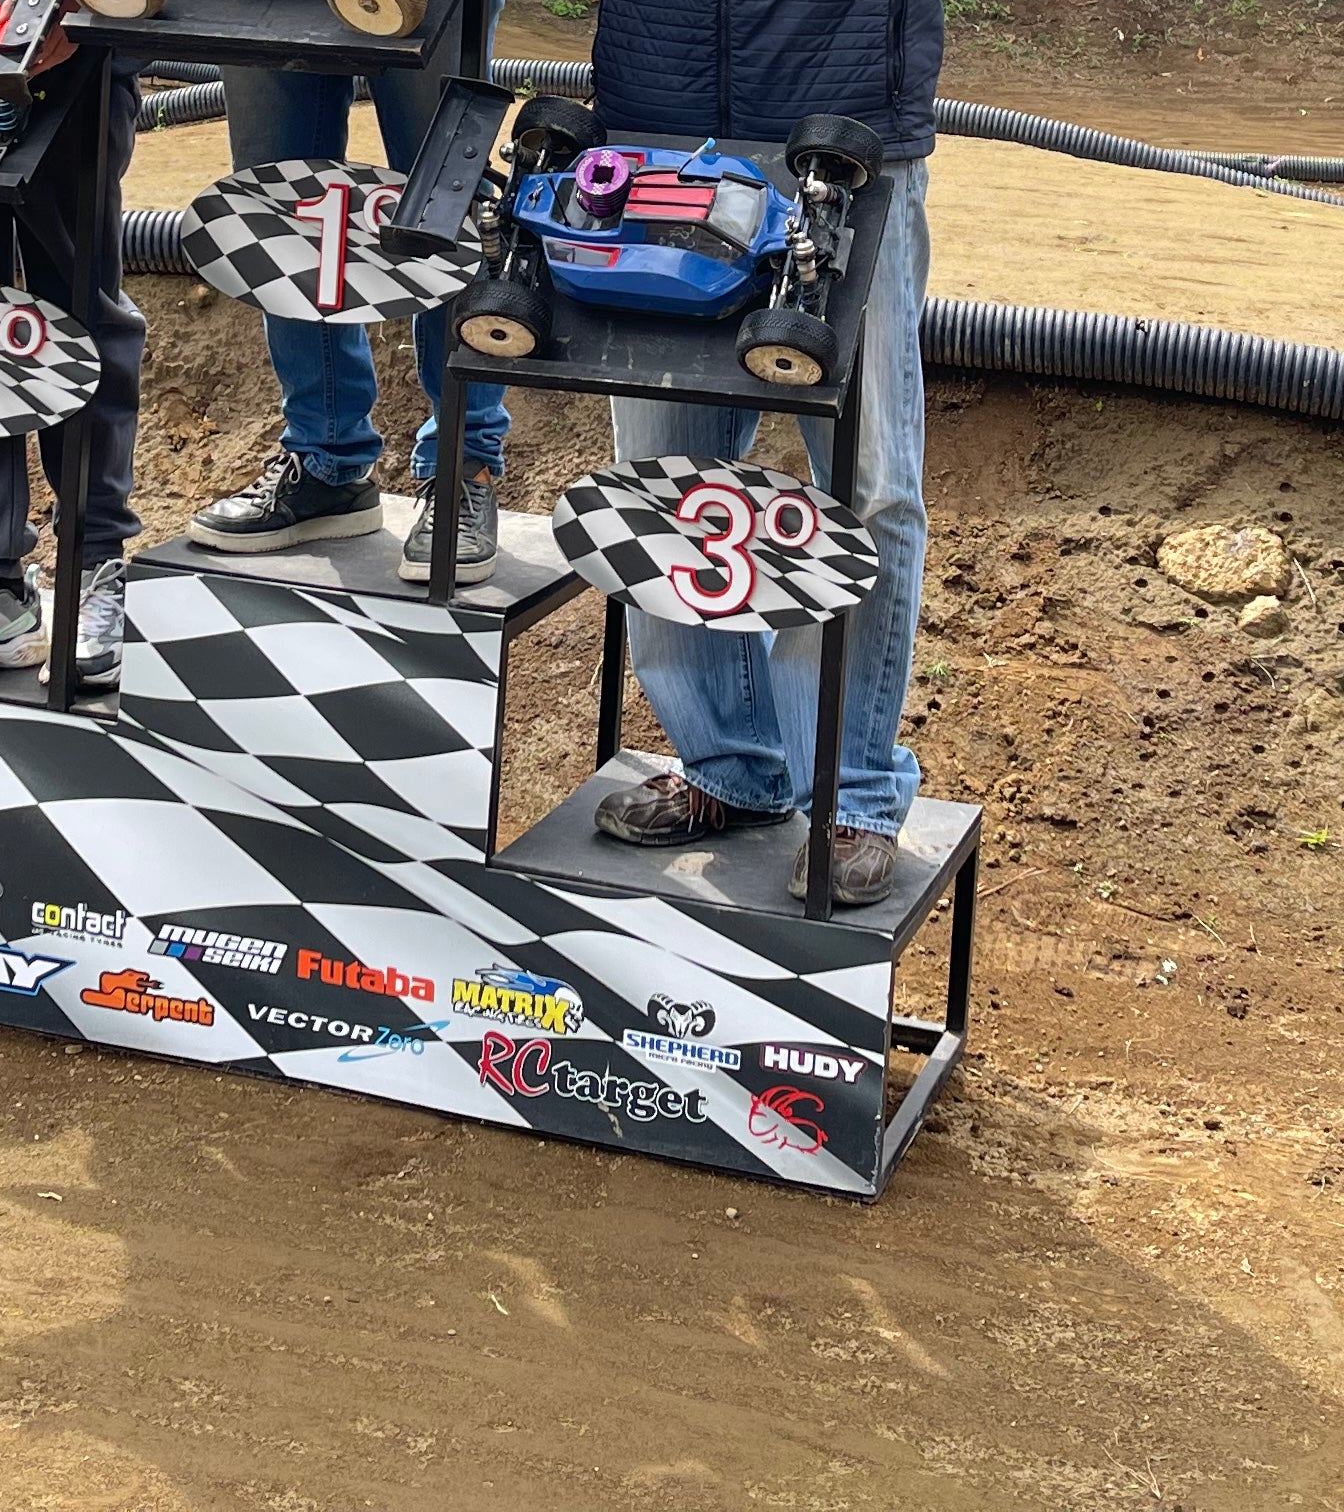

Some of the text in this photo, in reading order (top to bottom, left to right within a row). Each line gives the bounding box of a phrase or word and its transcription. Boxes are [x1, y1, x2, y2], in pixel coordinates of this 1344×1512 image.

[31, 901, 127, 939] contact
[297, 948, 436, 1003] Futaba
[452, 979, 570, 1035] MATRIX
[625, 1033, 740, 1067] SHEPHERD
[763, 1045, 865, 1084] HUDY
[477, 1030, 709, 1124] RC target
